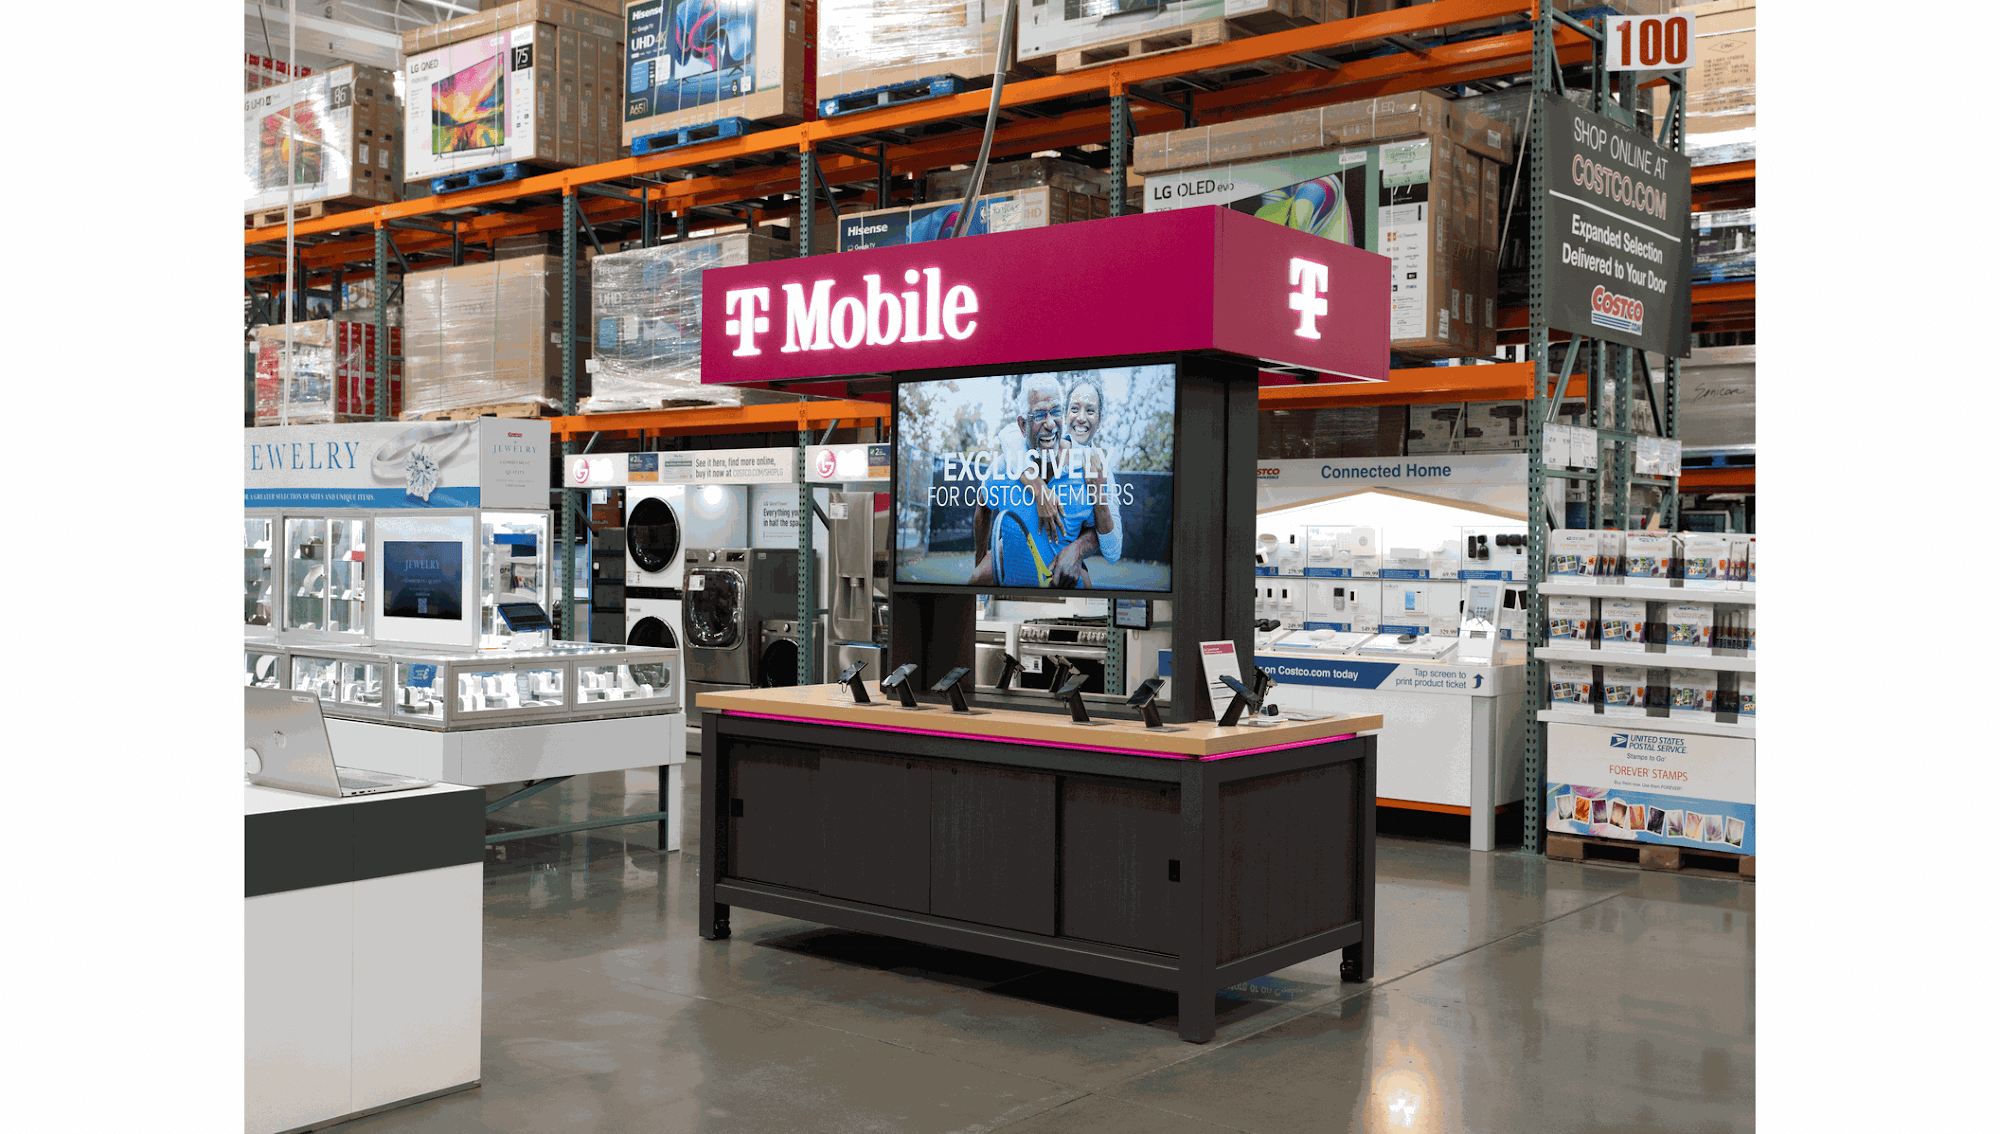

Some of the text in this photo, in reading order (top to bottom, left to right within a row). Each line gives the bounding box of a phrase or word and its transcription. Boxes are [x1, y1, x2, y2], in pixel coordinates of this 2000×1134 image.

[631, 34, 654, 51] UHD
[1616, 16, 1688, 66] 100
[410, 59, 439, 74] LG QNED
[334, 86, 348, 104] 86
[1574, 117, 1669, 180] SHOP ONLINE AT
[1154, 179, 1235, 200] LG OLED evo
[1572, 153, 1667, 221] COSTCO.COM
[847, 223, 888, 236] Hisense
[1571, 213, 1663, 264] Expanded Selection
[1562, 242, 1668, 294] Delivered to Your Door
[780, 267, 979, 353] Mobile
[1592, 285, 1643, 322] COSTCO
[249, 441, 360, 471] EWELRY
[492, 444, 537, 454] JEWELRY
[695, 458, 706, 468] See
[707, 458, 712, 467] it
[712, 457, 727, 468] here,
[728, 456, 740, 467] find
[740, 457, 756, 467] more
[756, 455, 776, 467] online,
[943, 447, 1115, 482] EXCLUSIVELY
[695, 469, 706, 480] buy
[707, 469, 712, 478] it
[712, 469, 725, 478] now
[725, 469, 732, 477] at
[1256, 468, 1280, 476] STCO
[1321, 463, 1452, 479] Connected Home
[336, 493, 356, 502] UNIQUE
[927, 483, 1134, 507] FOR COSTCO MEMBERS
[763, 508, 799, 518] Everything yo
[763, 518, 799, 528] in half the spa
[403, 559, 440, 572] JEWELRY
[1264, 666, 1277, 675] on
[1278, 665, 1331, 678] Costco.com
[1333, 667, 1359, 682] today
[1413, 668, 1467, 679] Tap screen to
[1395, 677, 1467, 689] print product ticket
[1629, 742, 1656, 752] POSTAL
[1630, 734, 1685, 746] UNITED STATES
[1626, 753, 1648, 761] Stamps
[1652, 768, 1688, 782] STAMPS
